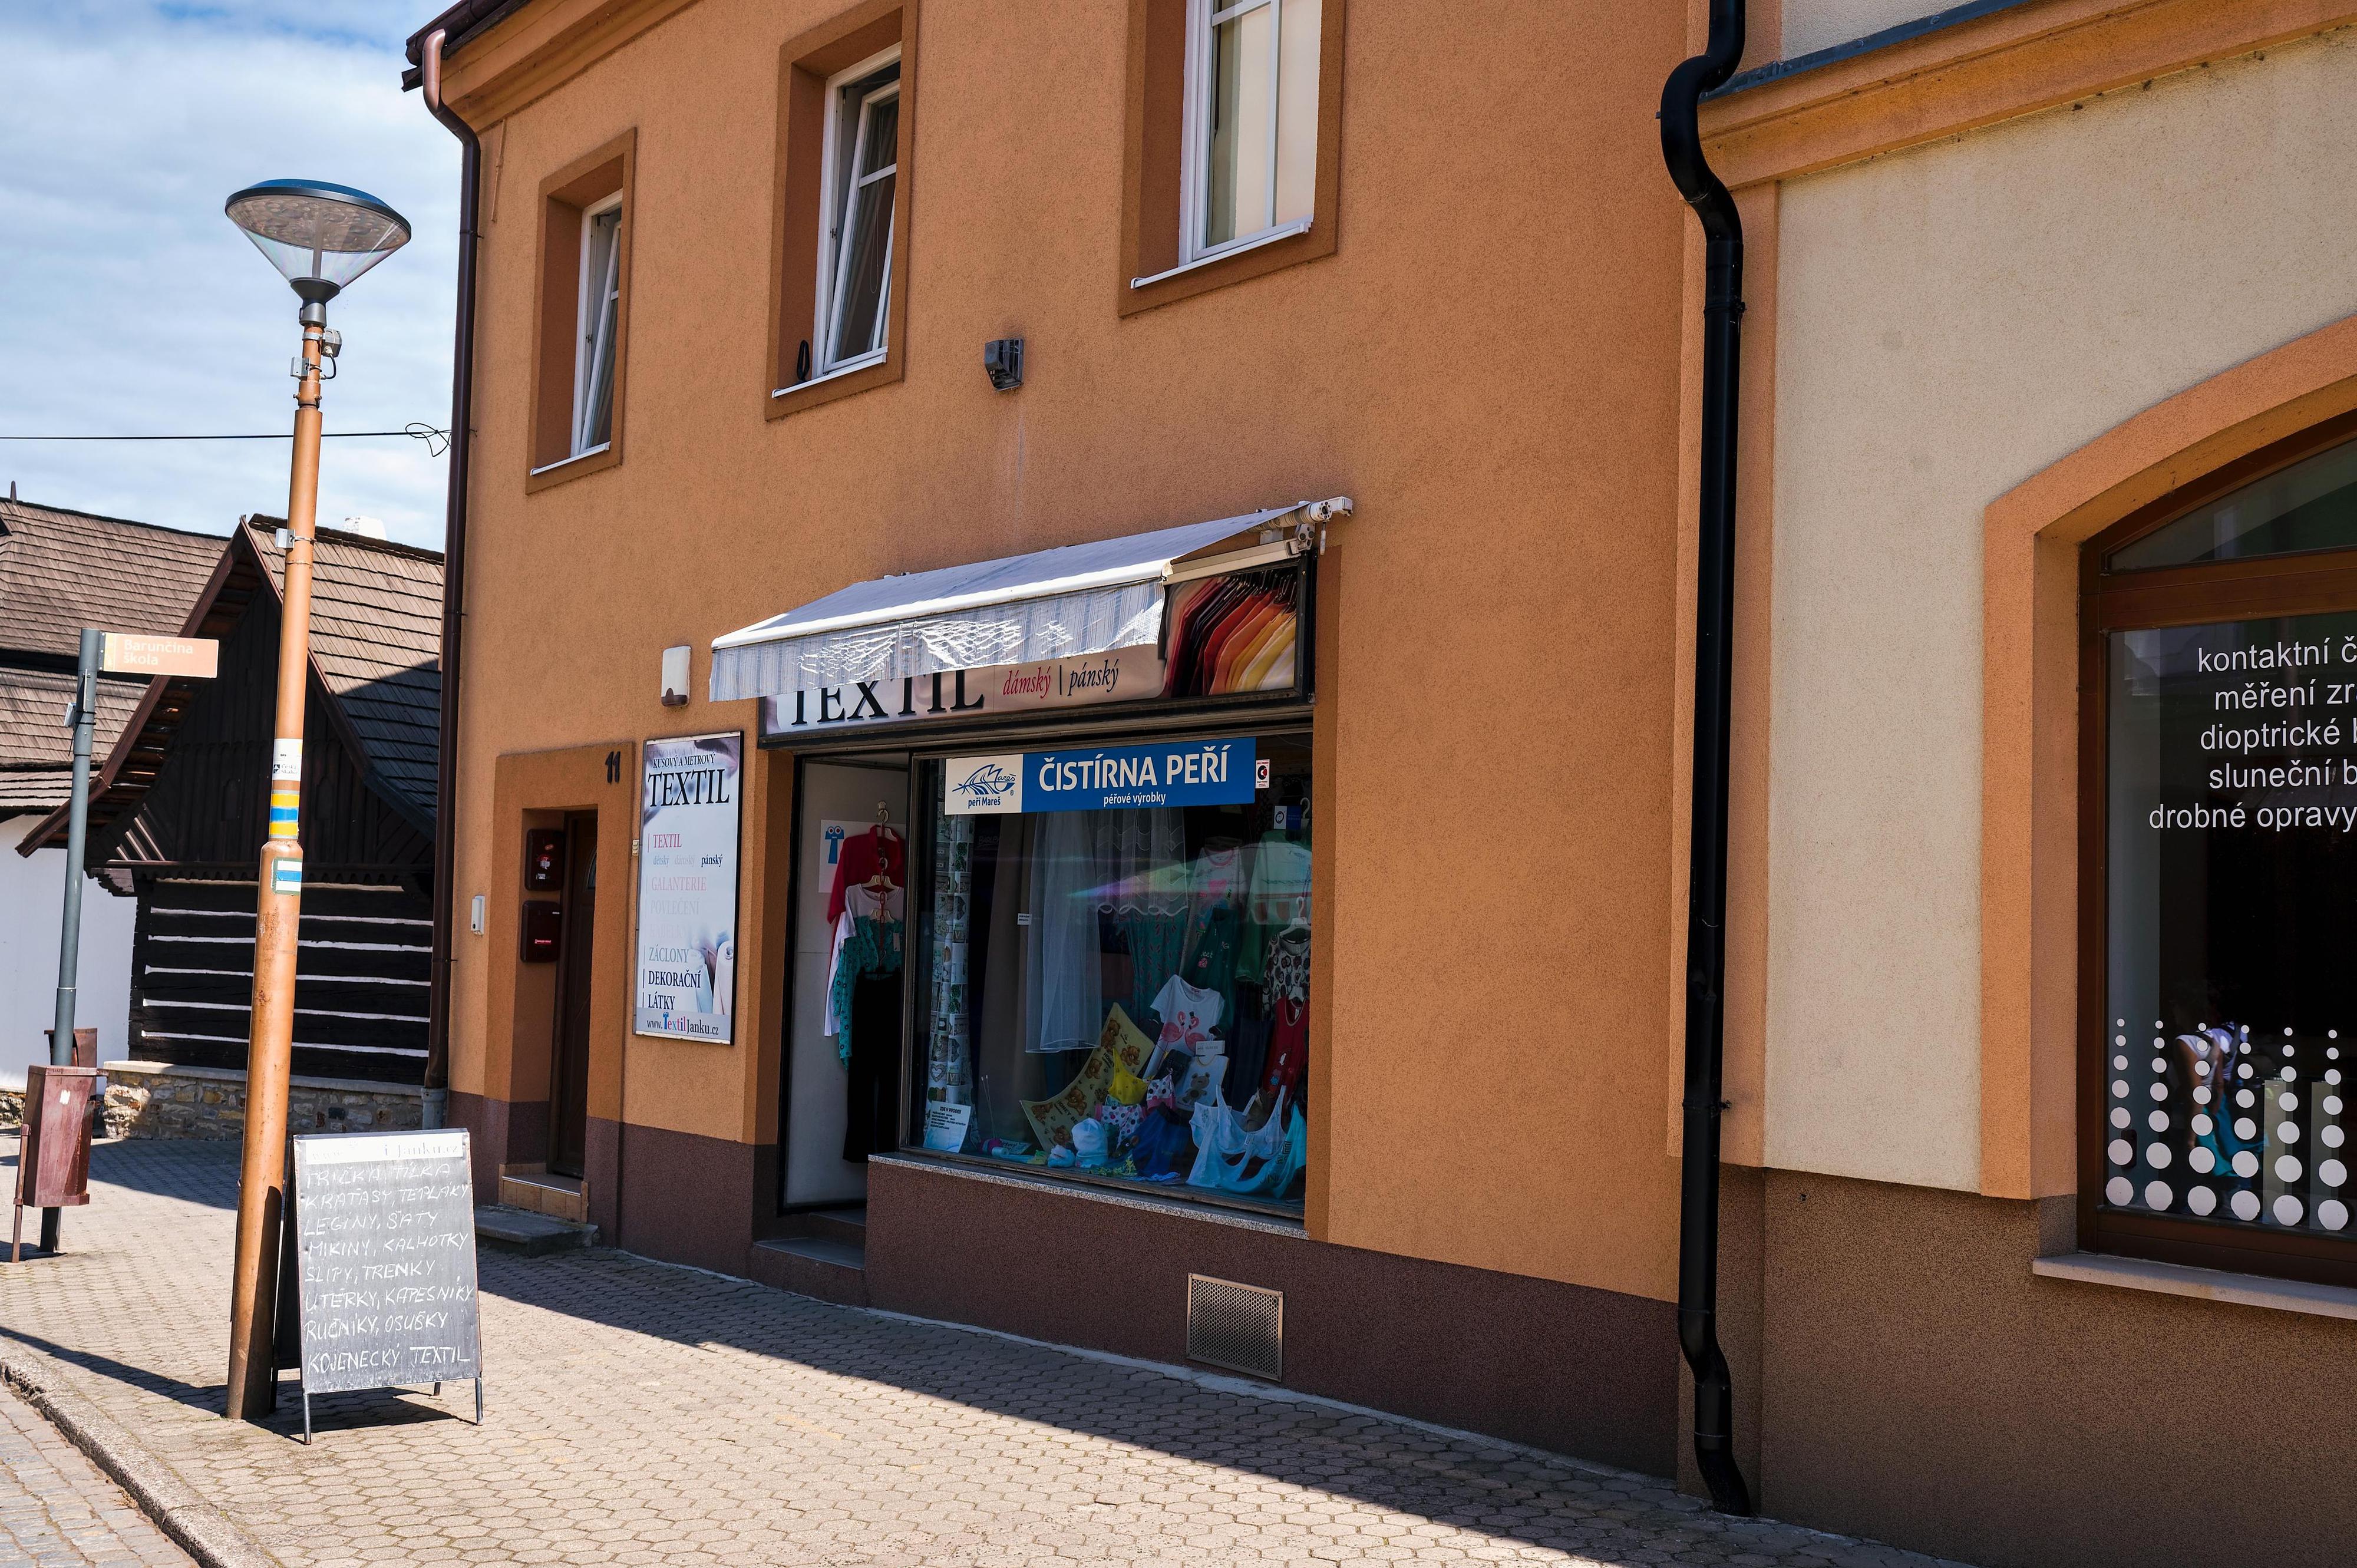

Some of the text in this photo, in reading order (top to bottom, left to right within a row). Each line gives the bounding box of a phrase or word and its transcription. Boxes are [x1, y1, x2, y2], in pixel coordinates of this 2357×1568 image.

[124, 639, 193, 654] Barunčina
[2198, 637, 2331, 672] kontaktní
[123, 652, 159, 665] škola
[1003, 658, 1120, 699] dámský pánský
[2215, 679, 2357, 710] měření zr
[2200, 717, 2340, 755] dioptrické
[605, 751, 621, 784] 11
[653, 751, 715, 768] KUSOVÝ A METROVÝ
[1039, 744, 1232, 791] ČISTÍRNA PEŘÍ
[2209, 759, 2330, 788] sluneční
[648, 768, 729, 807] TEXTIL
[1103, 791, 1166, 807] péřové výrobky
[968, 796, 1001, 809] peří Mareš
[2149, 801, 2357, 832] drobné opravy
[653, 833, 682, 849] TEXTIL
[701, 854, 723, 867] pánský
[651, 876, 707, 892] GALANTERIE
[649, 944, 689, 963] ZÁCLONY
[648, 969, 701, 988] DEKORAČNÍ
[648, 991, 676, 1010] LÁTKY
[393, 1161, 450, 1179] TÍLKA
[399, 1181, 468, 1202] TEPLÁKY
[387, 1211, 438, 1230] ŠATY
[308, 1232, 468, 1259] MIKINY, KALHOTKY
[305, 1259, 435, 1285] SLIPY, TRENKY
[385, 1276, 474, 1306] KAPESNÍKY
[303, 1310, 448, 1342] RUČNÍKY, OSUŠKY
[307, 1343, 470, 1375] KOJENECKÝ TEXTIL
